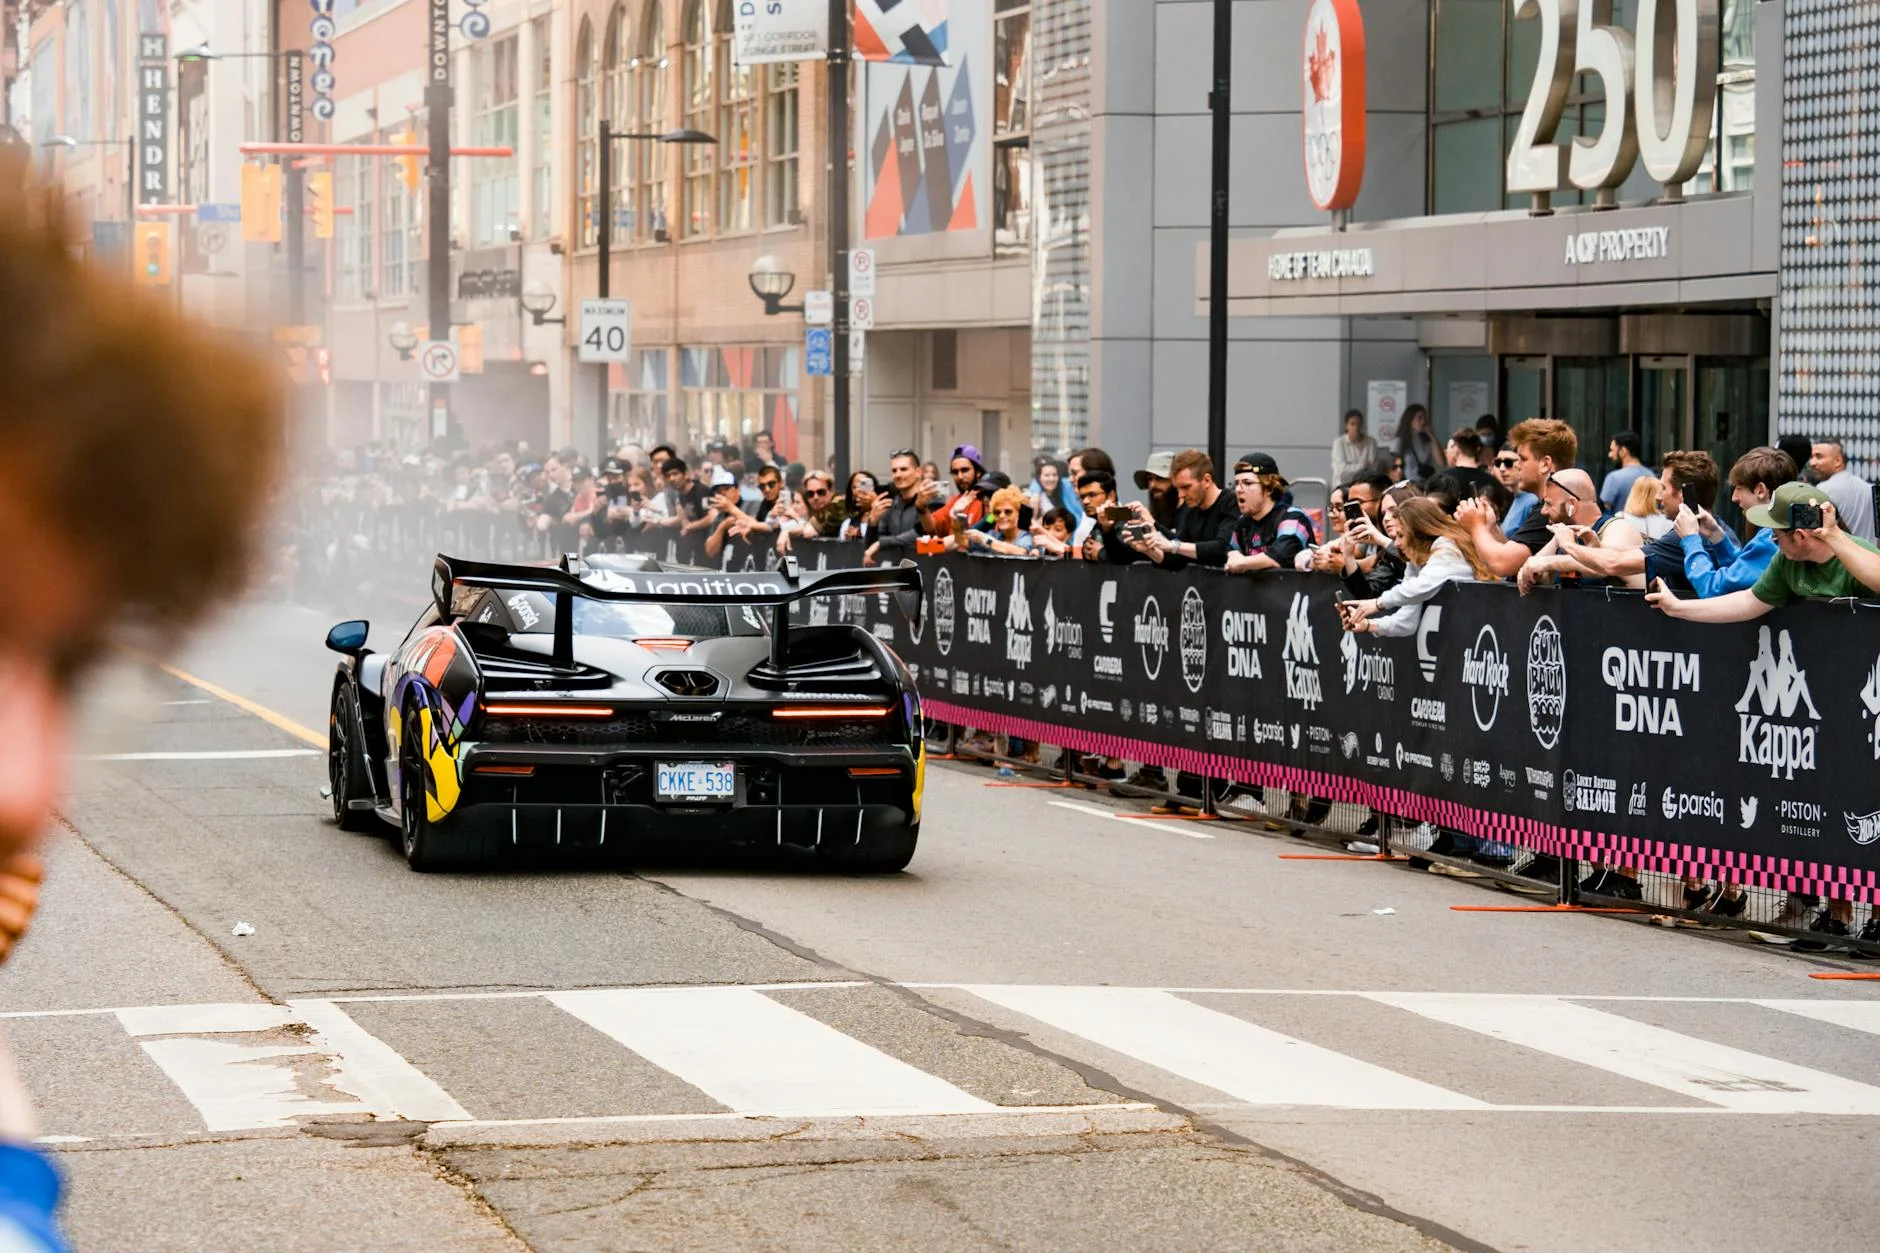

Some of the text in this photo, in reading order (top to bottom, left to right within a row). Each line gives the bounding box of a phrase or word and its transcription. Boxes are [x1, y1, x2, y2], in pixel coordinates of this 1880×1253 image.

[289, 56, 301, 142] OWNTOWN
[1506, 0, 1710, 191] 250
[1565, 234, 1576, 264] A
[1599, 225, 1669, 261] PROPERTY
[584, 325, 625, 352] 40
[967, 617, 992, 645] DNA
[1222, 610, 1267, 645] QNTM
[1228, 646, 1263, 680] DNA
[1358, 648, 1394, 692] Ignition
[1462, 647, 1509, 697] Hard Rock
[1601, 646, 1700, 692] QNTM
[1284, 660, 1324, 711] Kappa
[1411, 697, 1446, 723] CARRERA
[1615, 693, 1684, 737] DNA
[1262, 720, 1285, 747] parsiq
[1738, 713, 1817, 781] Kappa
[659, 771, 734, 792] CKKE 538
[1575, 787, 1617, 815] SALOON
[1678, 790, 1724, 825] parsiq
[1781, 800, 1822, 823] PISTON
[1781, 824, 1821, 838] DISTILLERY
